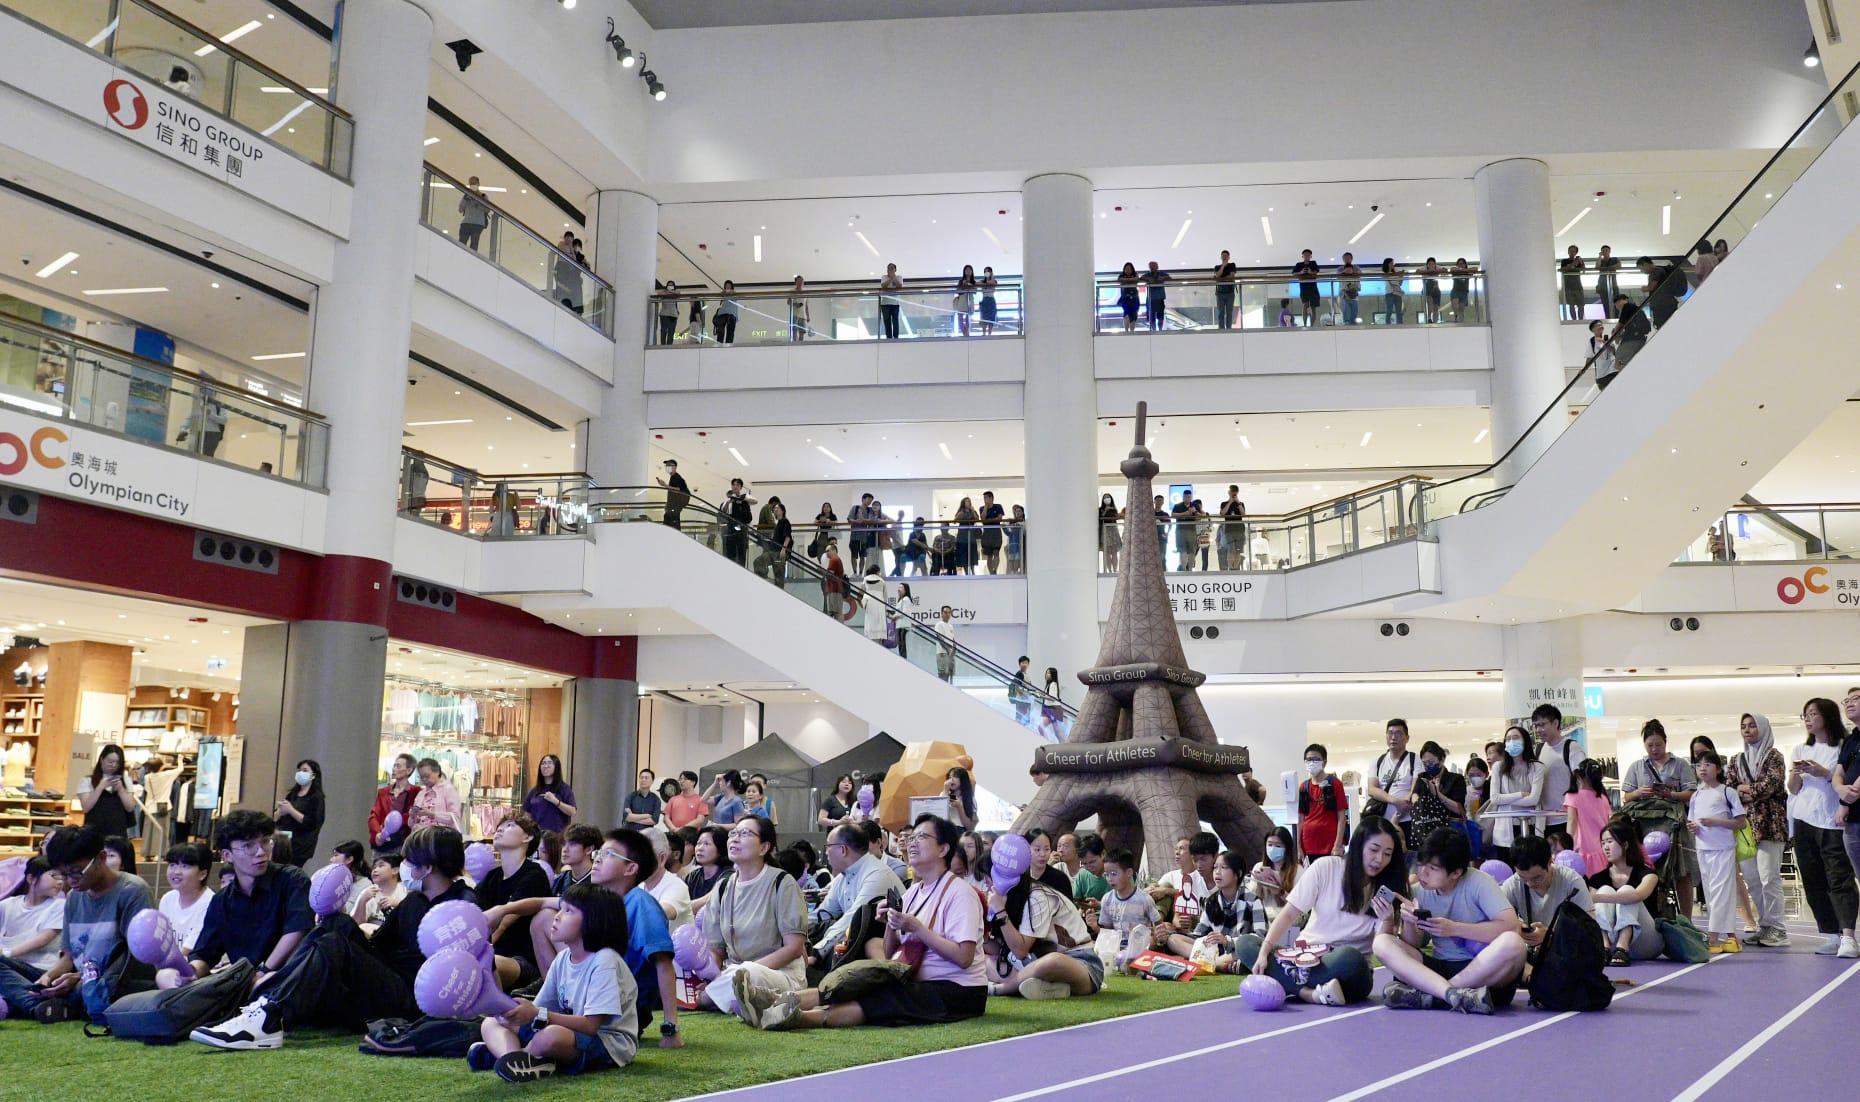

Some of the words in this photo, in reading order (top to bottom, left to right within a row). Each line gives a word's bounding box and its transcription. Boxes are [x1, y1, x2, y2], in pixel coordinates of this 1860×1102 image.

[157, 101, 201, 131] SINO
[205, 125, 263, 161] GROUP
[156, 122, 243, 178] 信和集團
[71, 451, 118, 476] 奧海城
[69, 472, 153, 504] Olympian
[156, 492, 189, 515] City
[1167, 583, 1198, 594] SINO
[1201, 582, 1252, 594] GROUP
[1777, 566, 1830, 605] OC
[951, 608, 976, 620] City
[1088, 671, 1111, 682] Sino
[1113, 669, 1147, 680] Group
[1166, 668, 1180, 681] Sino
[1045, 752, 1080, 766] Cheer
[1085, 751, 1103, 765] for
[1106, 745, 1156, 763] Athletes
[1182, 745, 1203, 758] Cheer
[1203, 748, 1213, 759] for
[1214, 752, 1246, 766] Athletes
[438, 967, 460, 999] Cheer
